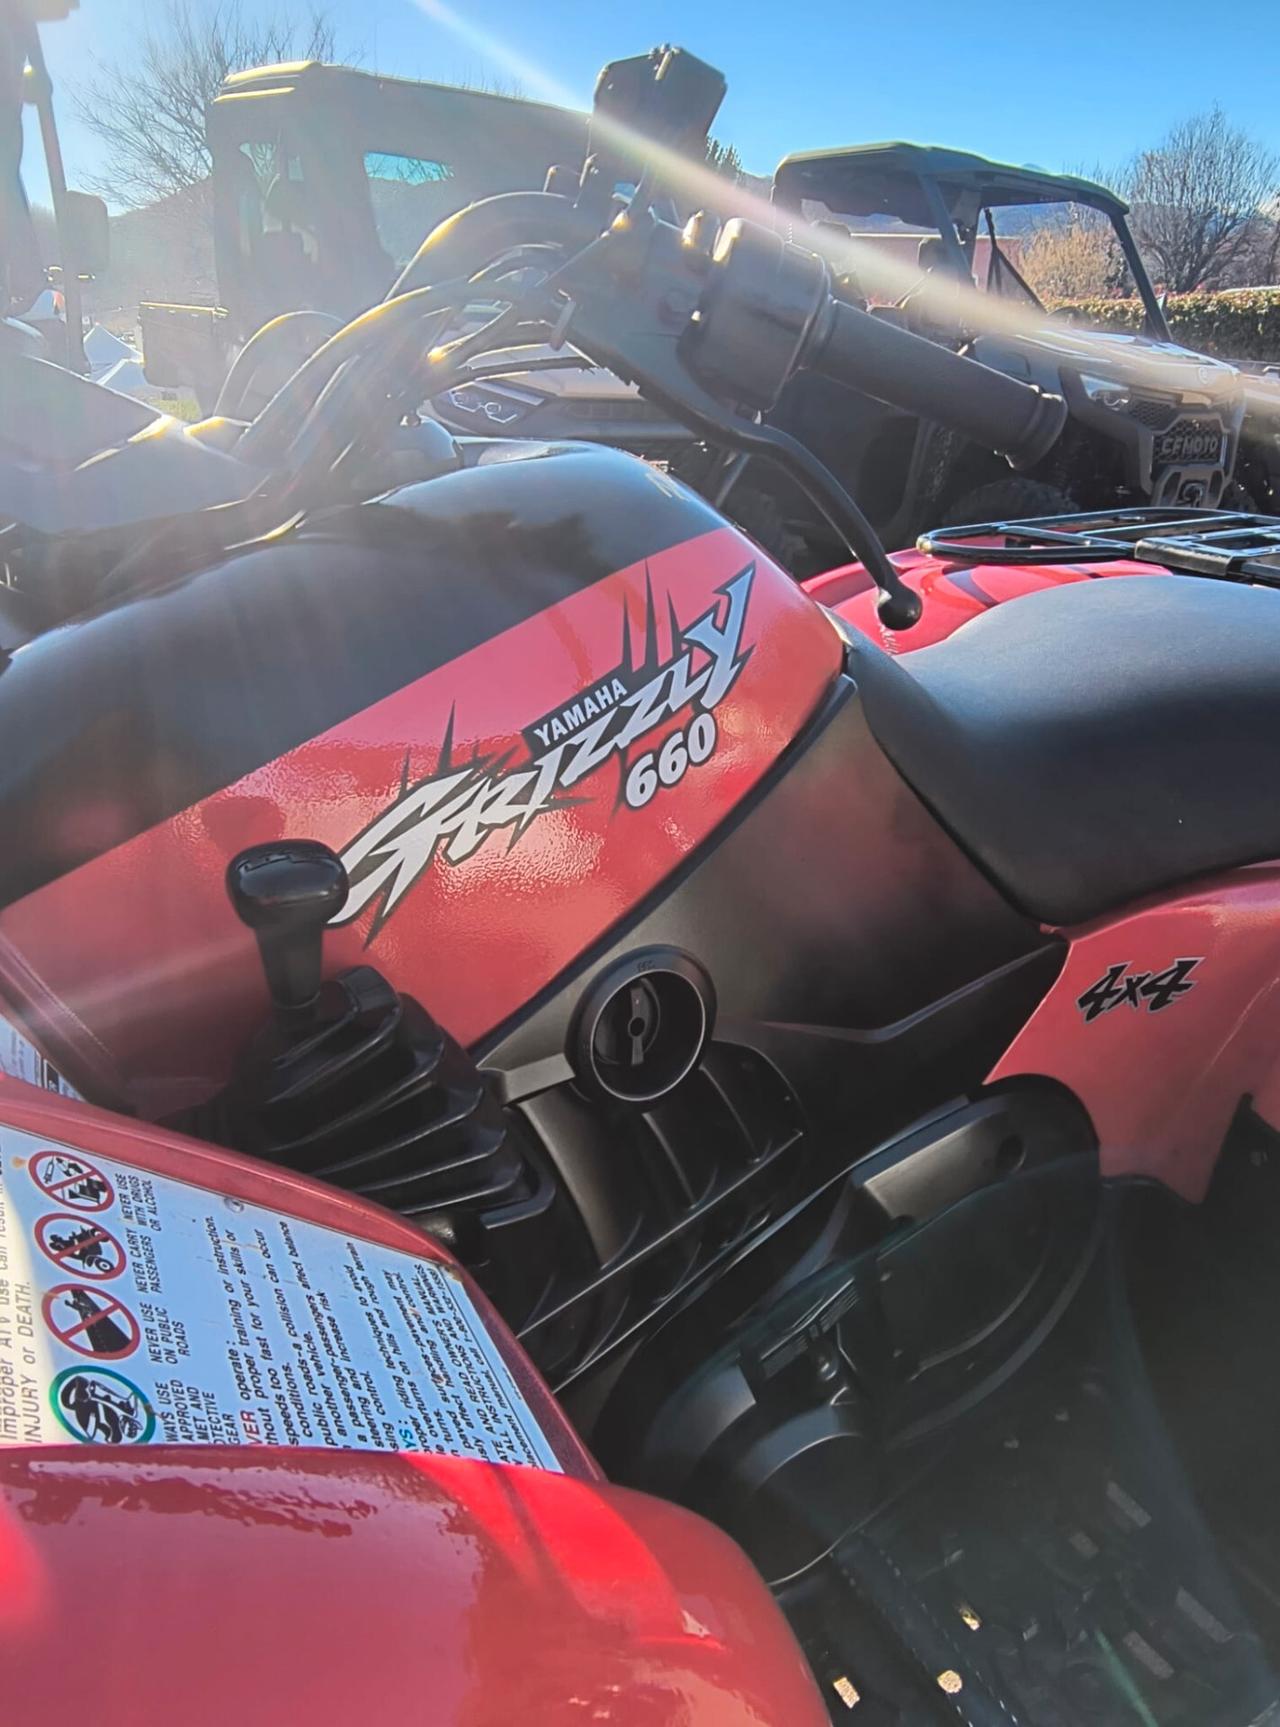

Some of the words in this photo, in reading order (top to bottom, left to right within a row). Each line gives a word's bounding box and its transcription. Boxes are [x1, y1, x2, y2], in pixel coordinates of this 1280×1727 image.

[1161, 435, 1219, 456] CFMOTO
[533, 678, 629, 748] YAMAHA
[625, 713, 717, 808] 660
[1077, 957, 1205, 1023] 4x4
[115, 1174, 128, 1190] USE
[119, 1193, 134, 1221] NEVER
[150, 1218, 162, 1232] OR
[225, 1229, 236, 1241] or
[279, 1221, 299, 1257] balance
[126, 1227, 142, 1258] CARRY
[205, 1216, 229, 1275] instruction.
[254, 1229, 271, 1259] occur
[347, 1242, 364, 1271] terrain
[140, 1235, 162, 1293] PASSENGERS
[230, 1247, 246, 1275] skills
[266, 1263, 279, 1283] can
[292, 1261, 311, 1290] affect
[132, 1262, 149, 1293] NEVER
[223, 1279, 235, 1293] or
[344, 1265, 363, 1292] avoid
[361, 1276, 379, 1304] rough
[382, 1269, 398, 1291] may
[240, 1279, 260, 1307] your
[359, 1296, 368, 1306] to
[14, 1282, 34, 1337] DEATH.
[139, 1302, 155, 1322] USE
[228, 1299, 250, 1346] training
[250, 1313, 263, 1330] for
[274, 1288, 298, 1337] collision
[374, 1308, 390, 1328] and
[413, 1313, 428, 1334] and
[155, 1307, 173, 1344] PUBLIC
[172, 1321, 190, 1356] ROADS
[327, 1315, 351, 1362] increase
[365, 1312, 395, 1369] techniques
[442, 1318, 459, 1340] AND
[22, 1347, 35, 1364] or
[145, 1328, 163, 1363] NEVER
[163, 1349, 178, 1364] ON
[256, 1336, 273, 1360] fast
[303, 1331, 325, 1377] vehicle.
[386, 1333, 401, 1355] hills
[469, 1347, 485, 1366] call
[243, 1353, 269, 1399] proper
[344, 1367, 362, 1390] and
[399, 1360, 410, 1375] on
[426, 1340, 454, 1387] handling
[155, 1382, 171, 1405] USE
[267, 1368, 282, 1390] too
[392, 1375, 413, 1409] riding
[455, 1344, 502, 1424] INSTRUCTIONS
[459, 1372, 481, 1403] READ
[0, 1359, 20, 1440] Improper
[20, 1375, 42, 1443] INJURY
[170, 1380, 195, 1442] APPROVED
[186, 1386, 203, 1411] AND
[281, 1362, 313, 1438] conditions.
[320, 1383, 347, 1437] another
[407, 1381, 438, 1438] overturns
[451, 1395, 474, 1429] affect
[222, 1414, 240, 1445] GEAR
[274, 1394, 300, 1446] speeds
[312, 1402, 338, 1446] public
[357, 1396, 384, 1448] steering
[446, 1410, 474, 1450] paved
[476, 1408, 496, 1434] AND
[357, 1434, 367, 1443] a
[499, 1431, 517, 1453] ALL
